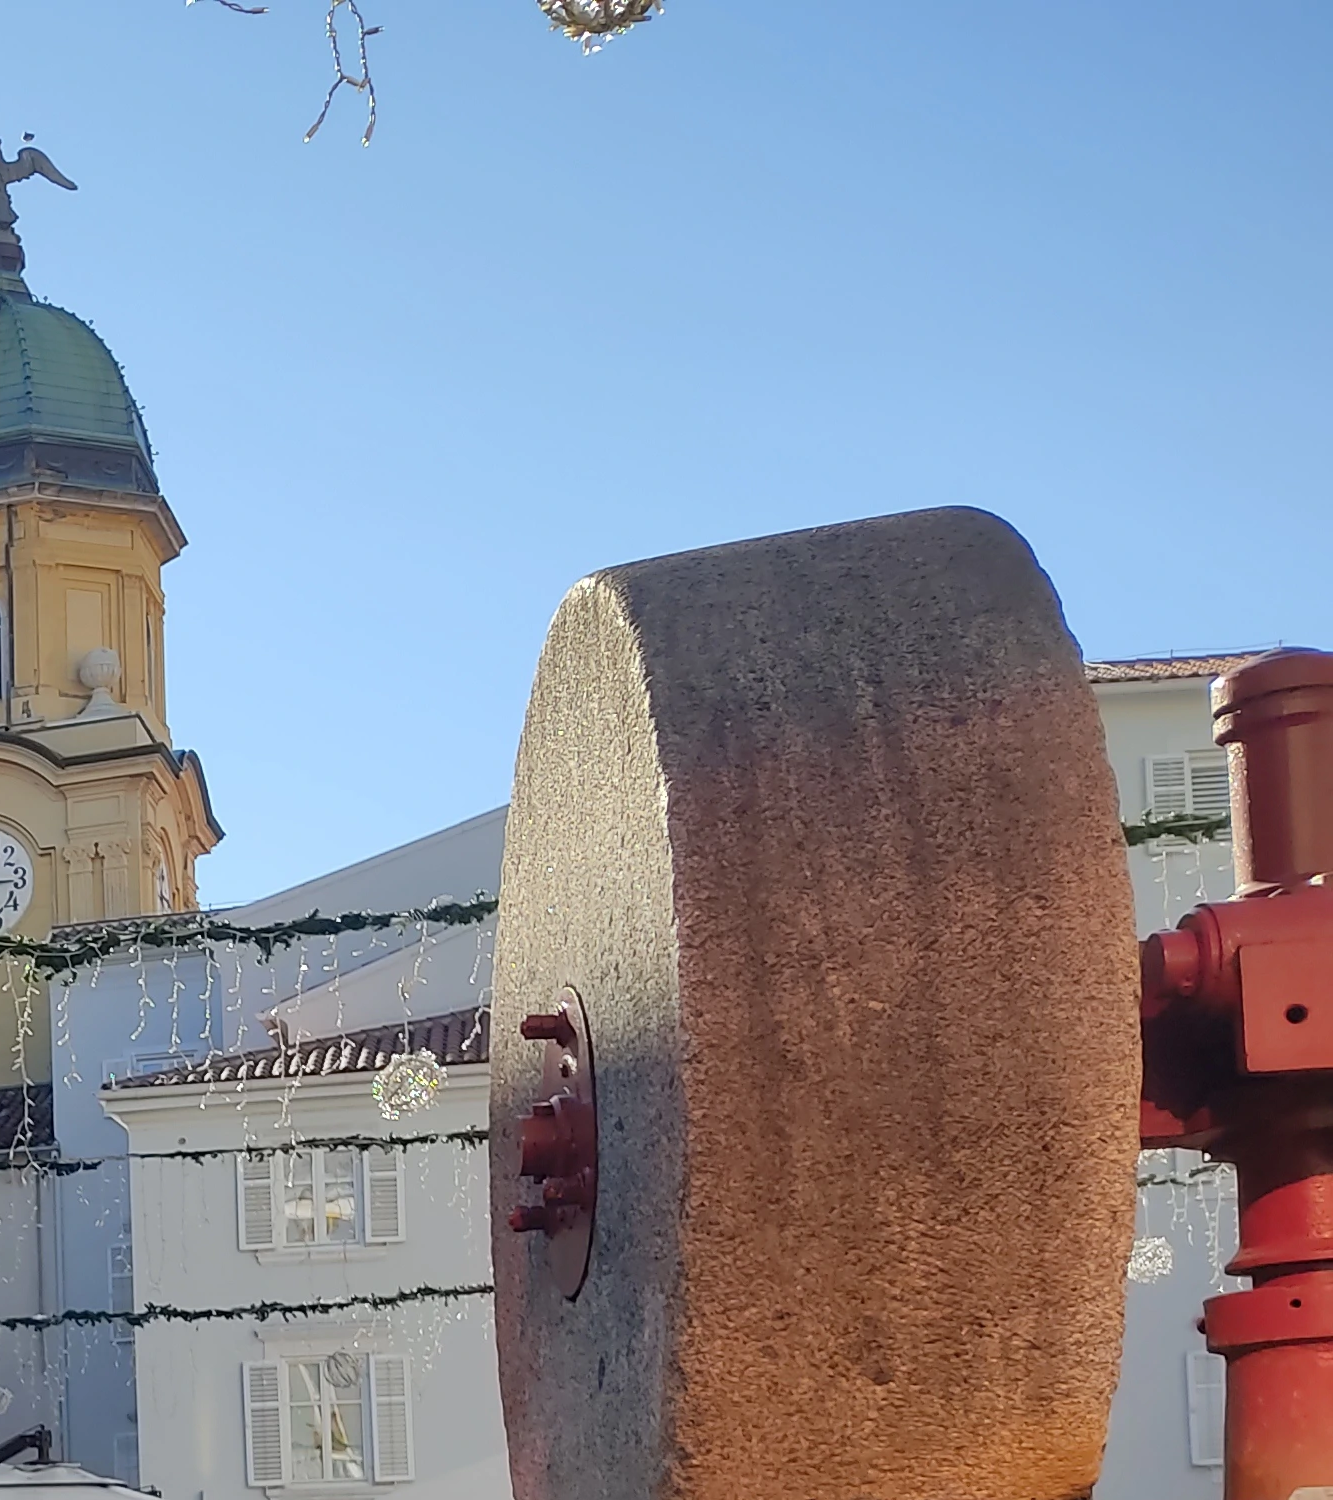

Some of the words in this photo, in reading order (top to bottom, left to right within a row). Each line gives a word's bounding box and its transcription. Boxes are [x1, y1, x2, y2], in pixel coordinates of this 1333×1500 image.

[4, 846, 15, 867] 2
[14, 866, 26, 889] 3
[4, 890, 19, 911] 4
